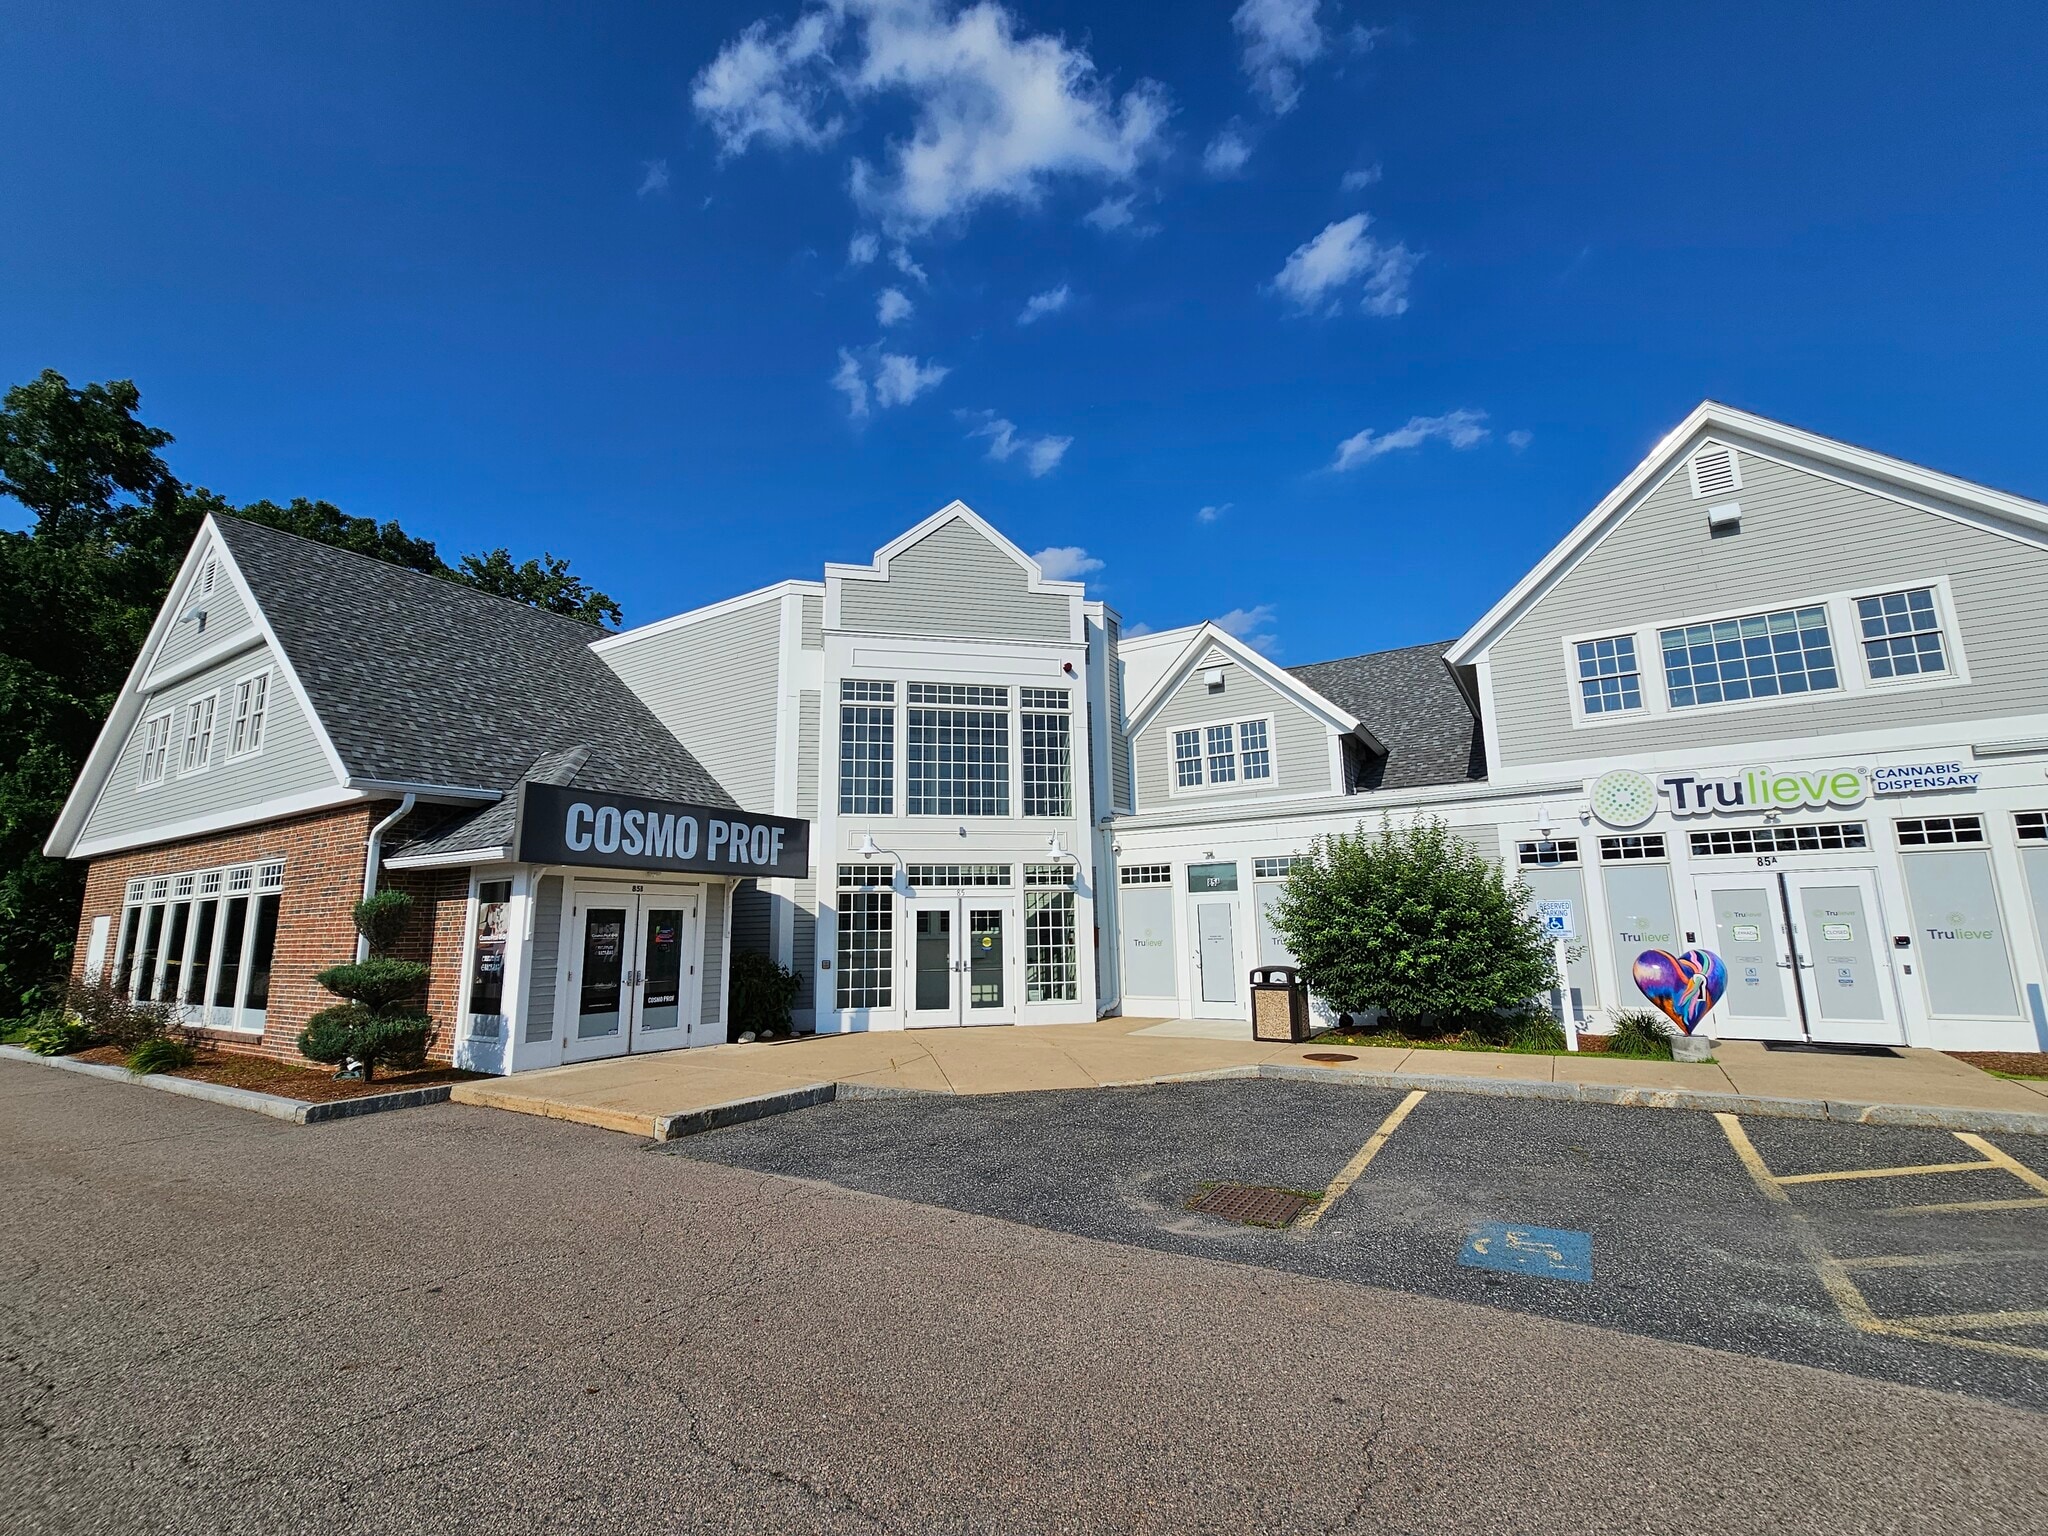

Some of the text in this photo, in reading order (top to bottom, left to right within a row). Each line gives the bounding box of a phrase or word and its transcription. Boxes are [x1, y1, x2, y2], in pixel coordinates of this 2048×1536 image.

[1875, 763, 1960, 779] CANNABIS
[1663, 770, 1861, 809] Trulieve
[1877, 774, 1979, 791] DISPENSARY
[565, 802, 785, 866] COSMO PROF
[956, 888, 965, 896] 85
[1543, 909, 1569, 917] ARKING
[1619, 932, 1670, 942] Trulieve
[1926, 928, 1993, 940] Trulieve
